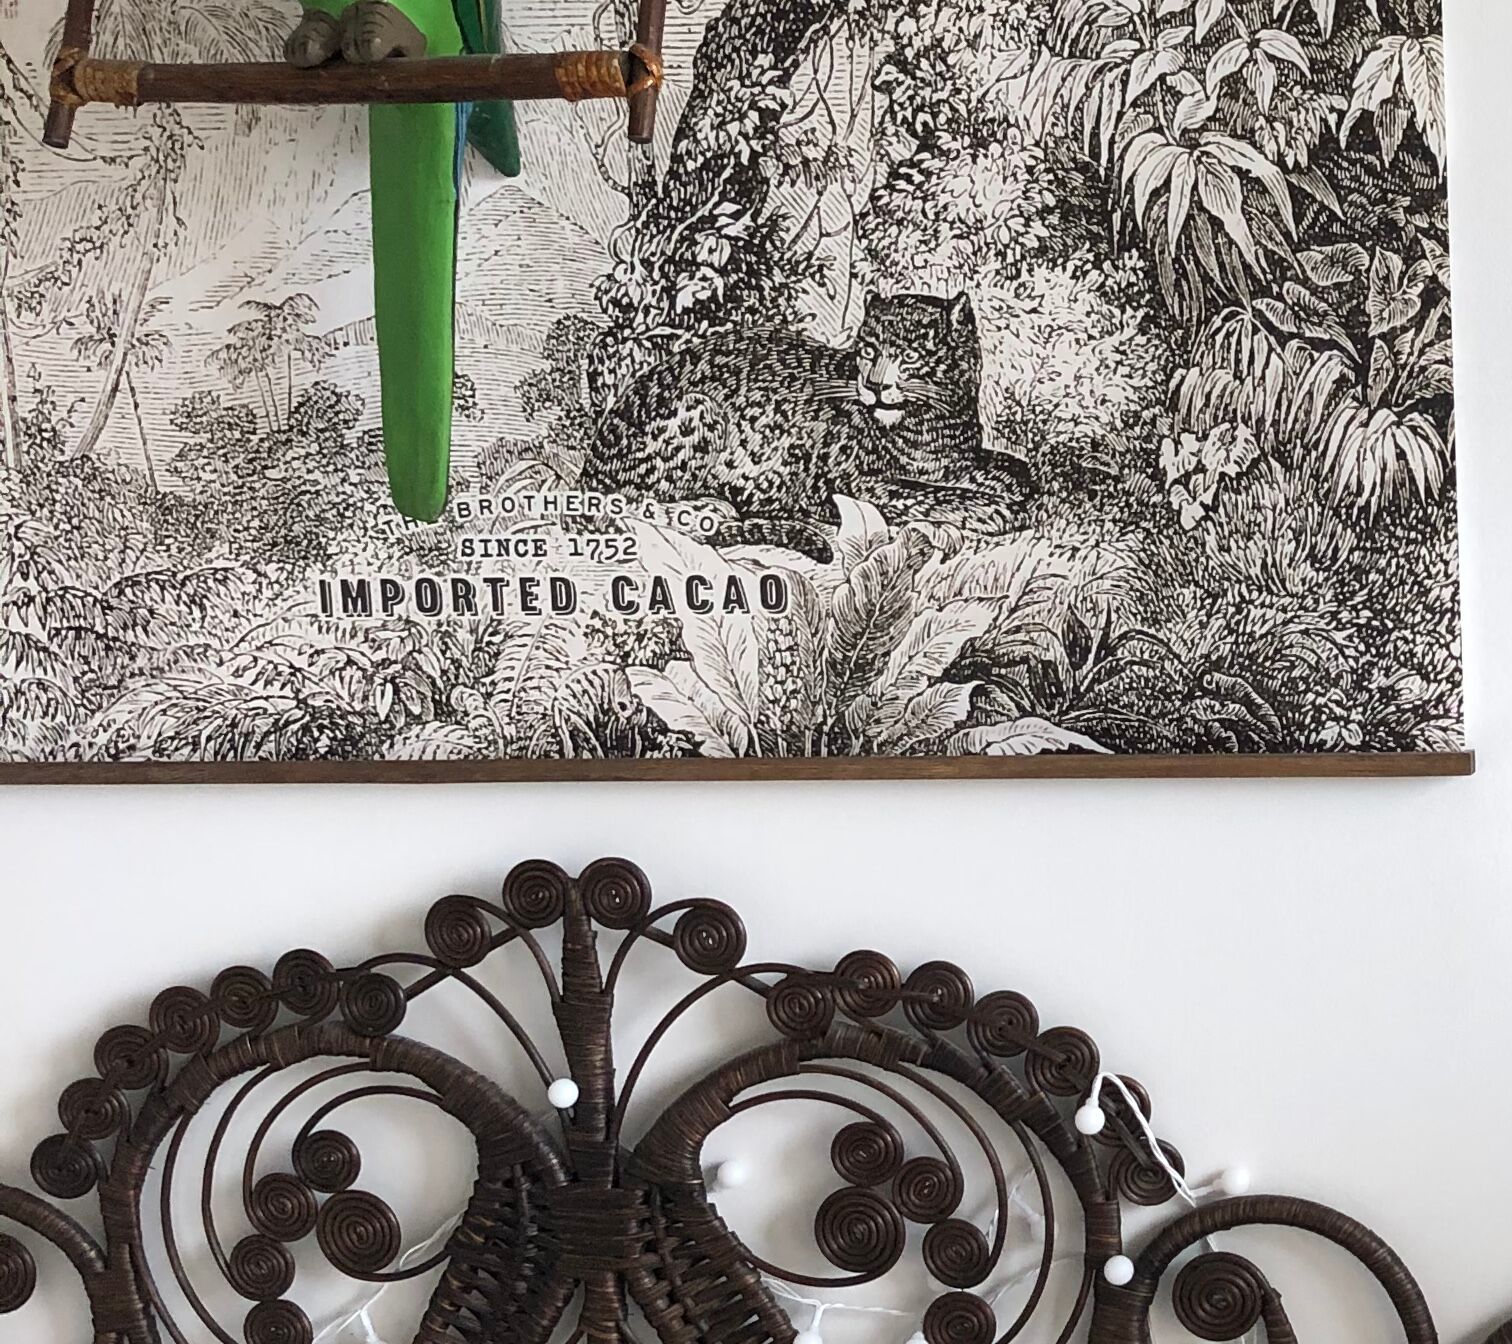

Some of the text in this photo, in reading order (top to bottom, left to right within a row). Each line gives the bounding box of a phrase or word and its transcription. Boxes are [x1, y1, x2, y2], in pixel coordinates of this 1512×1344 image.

[382, 494, 715, 536] TH BROTHERS & CO
[461, 536, 638, 561] SINCE 1752
[318, 573, 788, 618] IMPORTED CACAO
